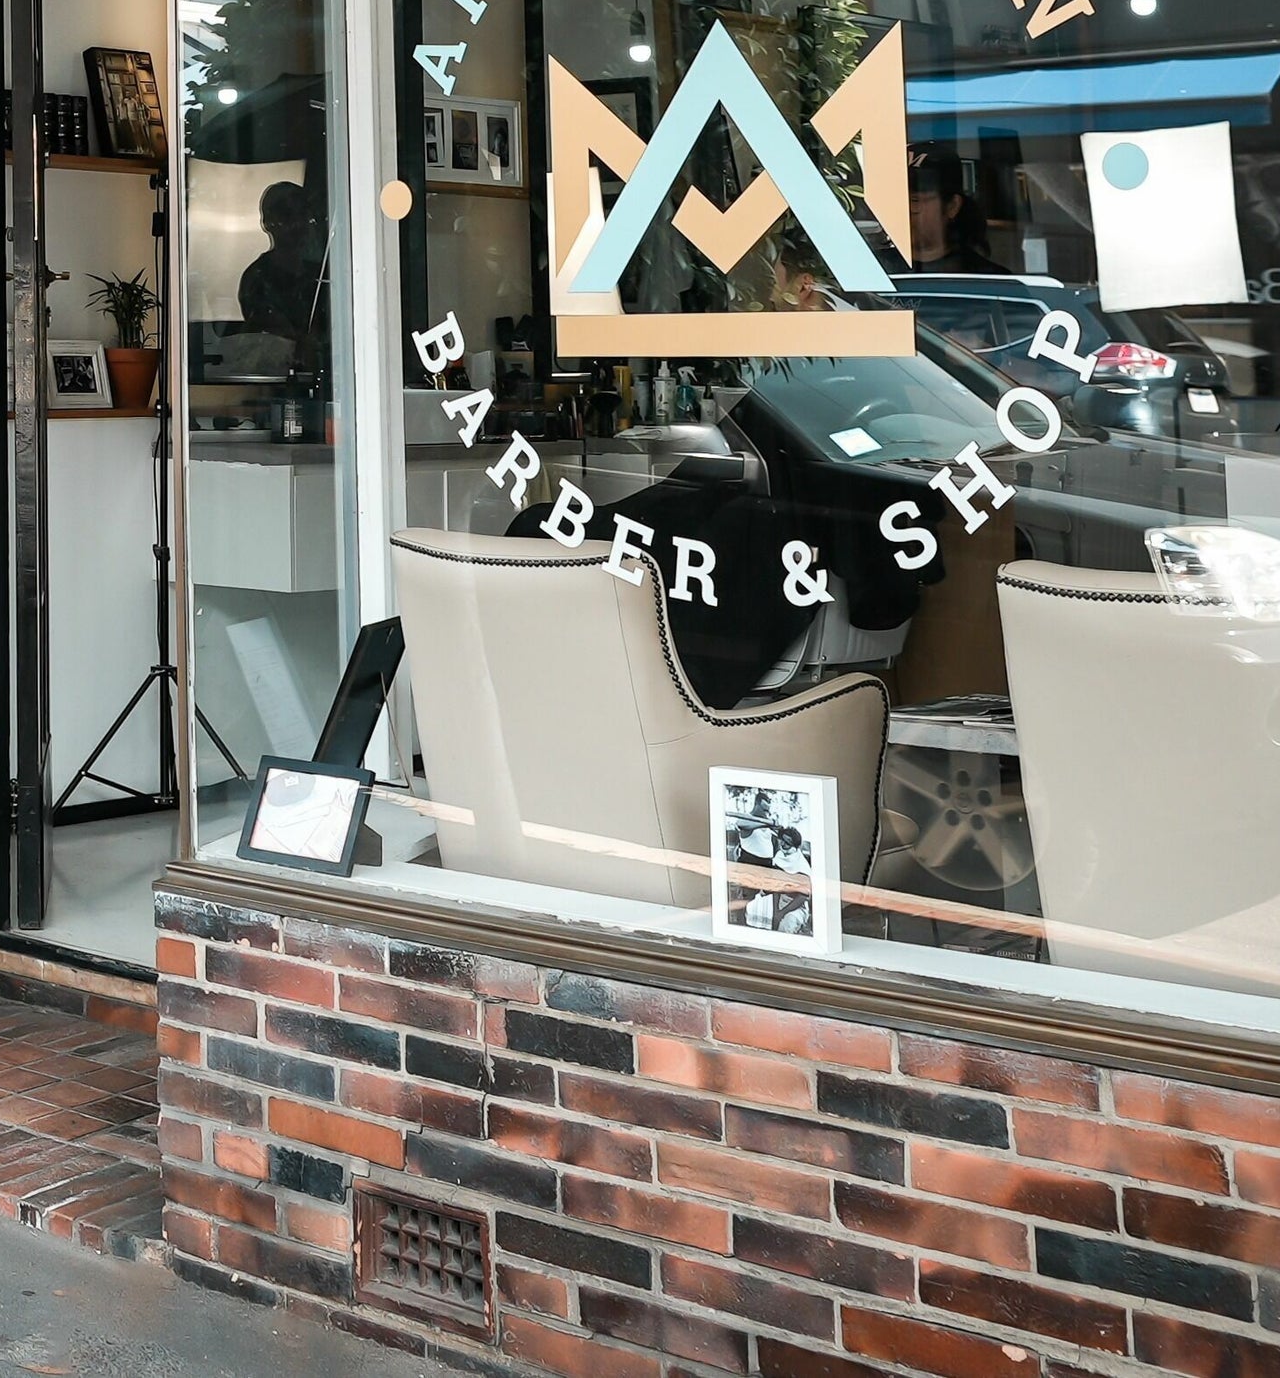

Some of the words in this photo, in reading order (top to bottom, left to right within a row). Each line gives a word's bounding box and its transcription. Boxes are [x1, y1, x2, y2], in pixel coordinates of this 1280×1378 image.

[411, 310, 719, 607] BARBER
[780, 539, 835, 607] &
[878, 308, 1097, 571] SHOP
